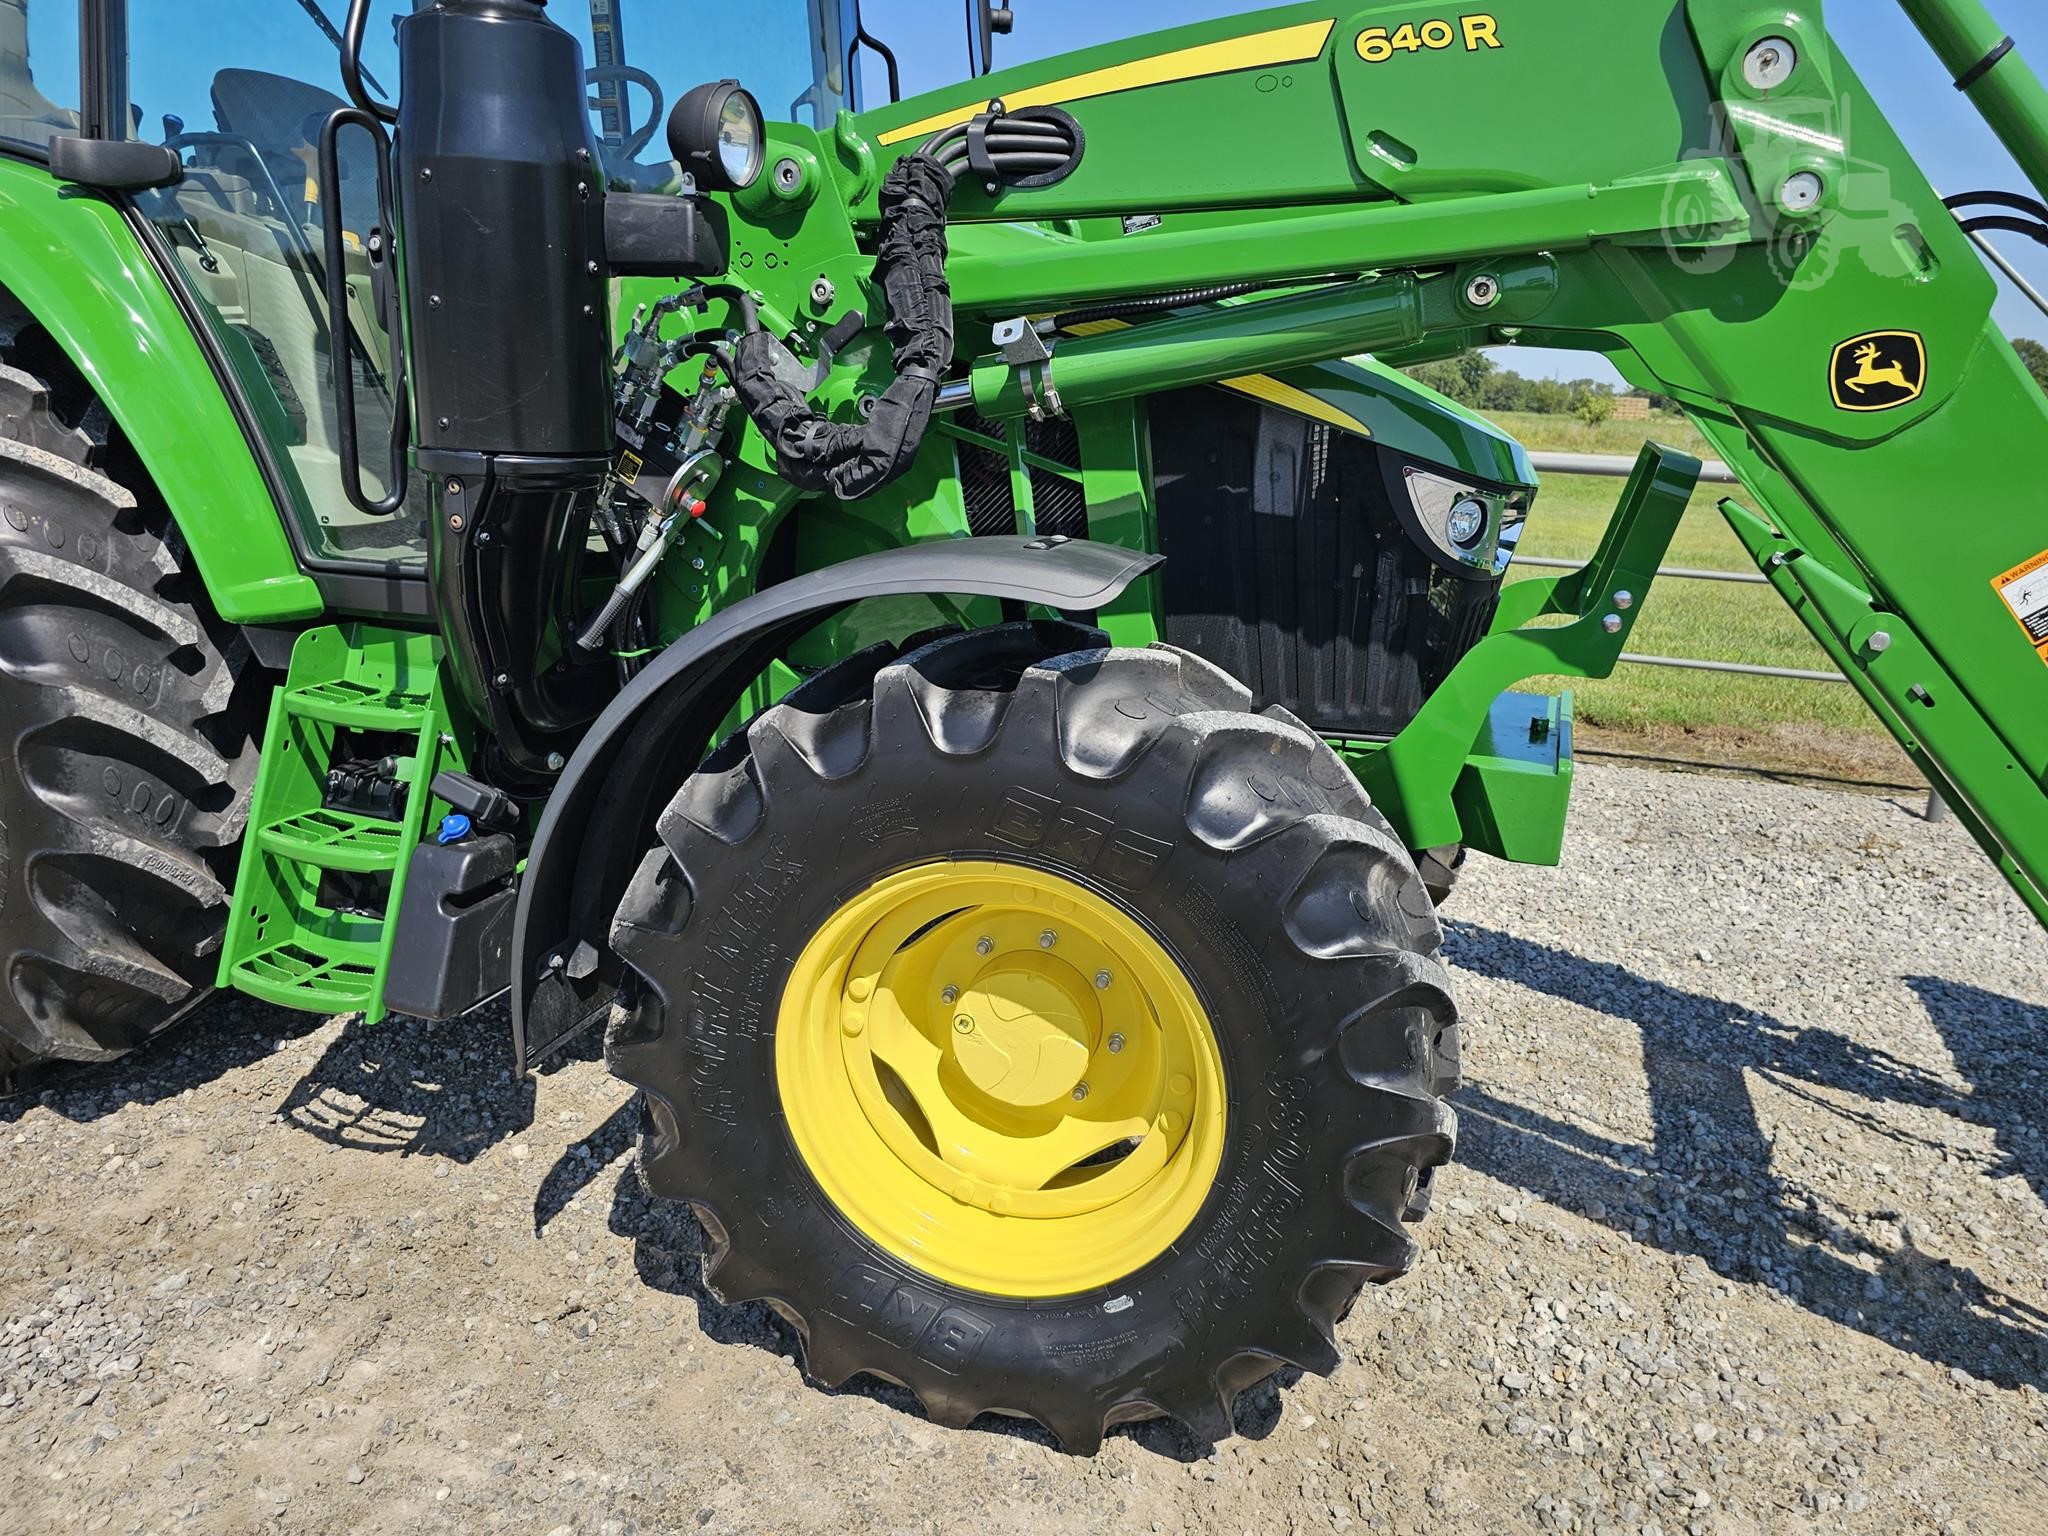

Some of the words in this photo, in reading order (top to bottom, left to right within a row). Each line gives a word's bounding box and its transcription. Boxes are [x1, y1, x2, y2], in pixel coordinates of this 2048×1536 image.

[1354, 19, 1454, 63] 640
[1459, 13, 1504, 52] R
[987, 788, 1170, 890] BKT
[818, 1265, 990, 1373] BKT
